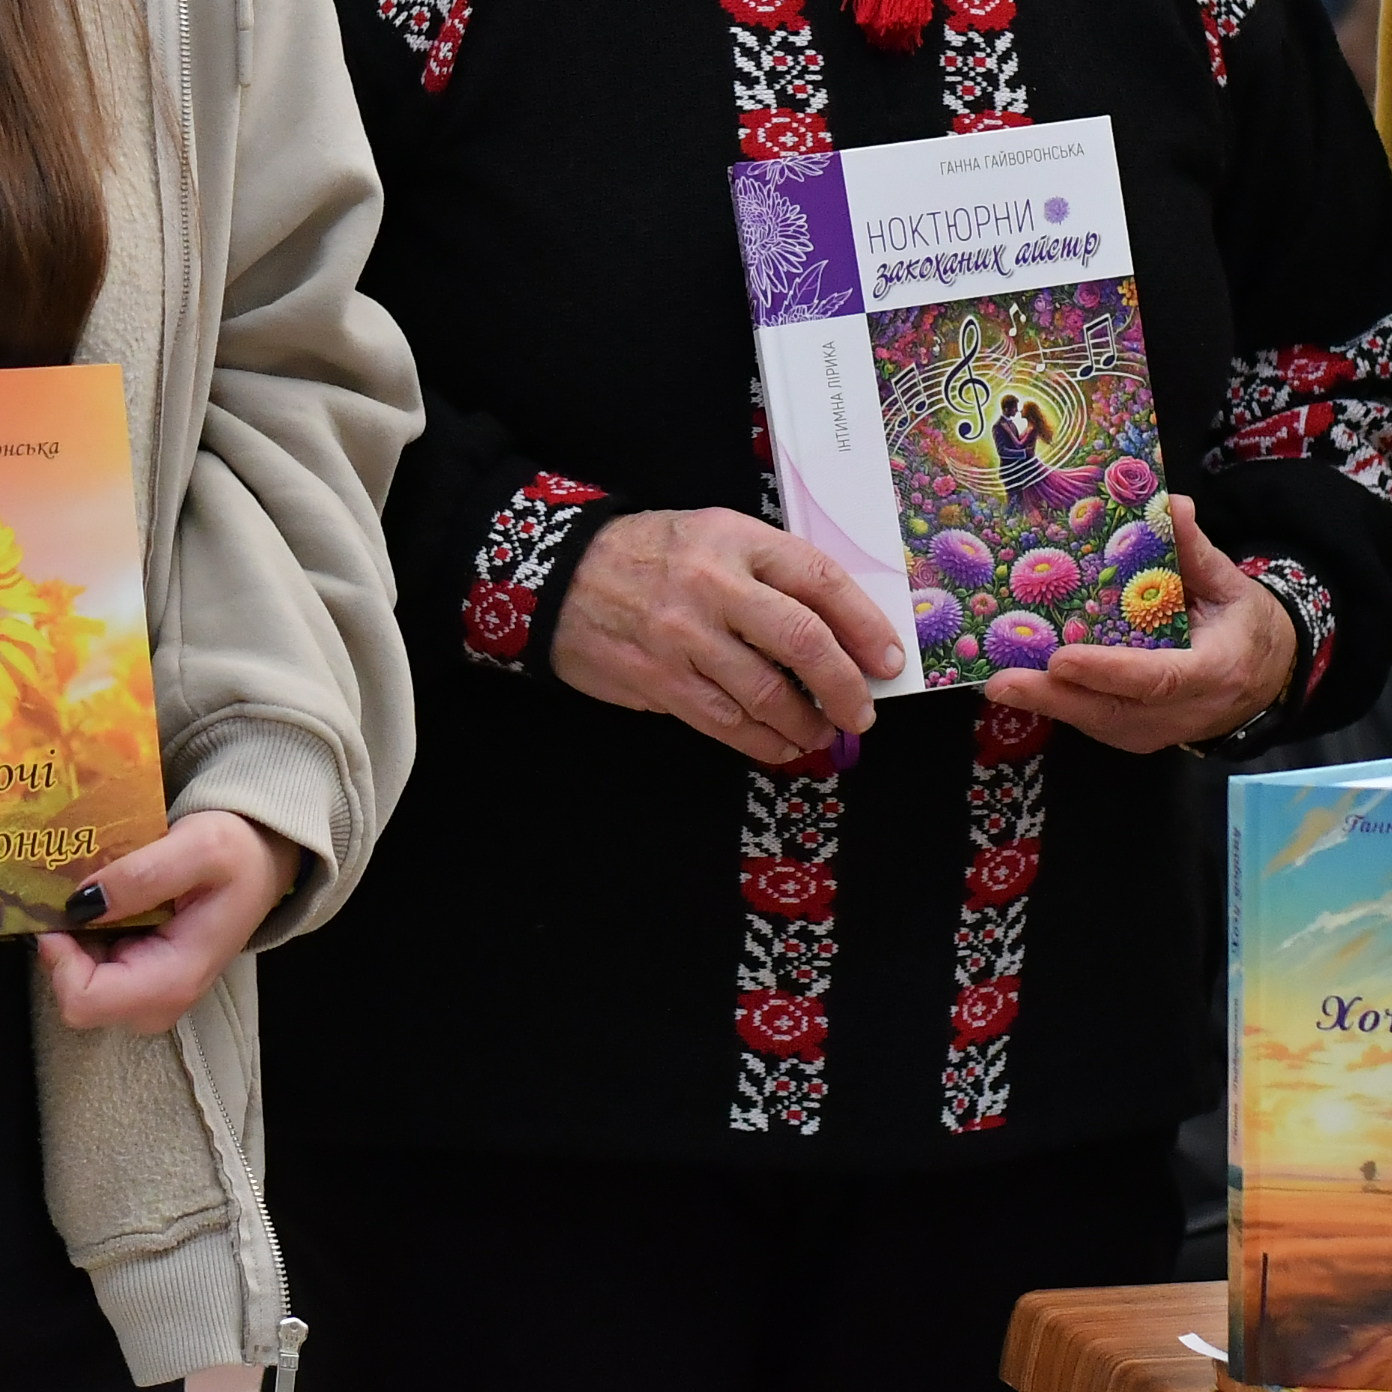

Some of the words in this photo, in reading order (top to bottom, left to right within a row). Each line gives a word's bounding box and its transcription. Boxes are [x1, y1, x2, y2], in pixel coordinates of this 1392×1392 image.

[940, 157, 981, 175] ГАННА
[985, 142, 1085, 170] ГАЙВОРОНСЬКА
[867, 199, 1035, 254] НОКТЮРНИ
[872, 244, 1013, 299] закоханих
[1014, 231, 1100, 268] айстр
[822, 340, 843, 388] ЛІРИКА
[830, 392, 851, 452] ІНТИМНА
